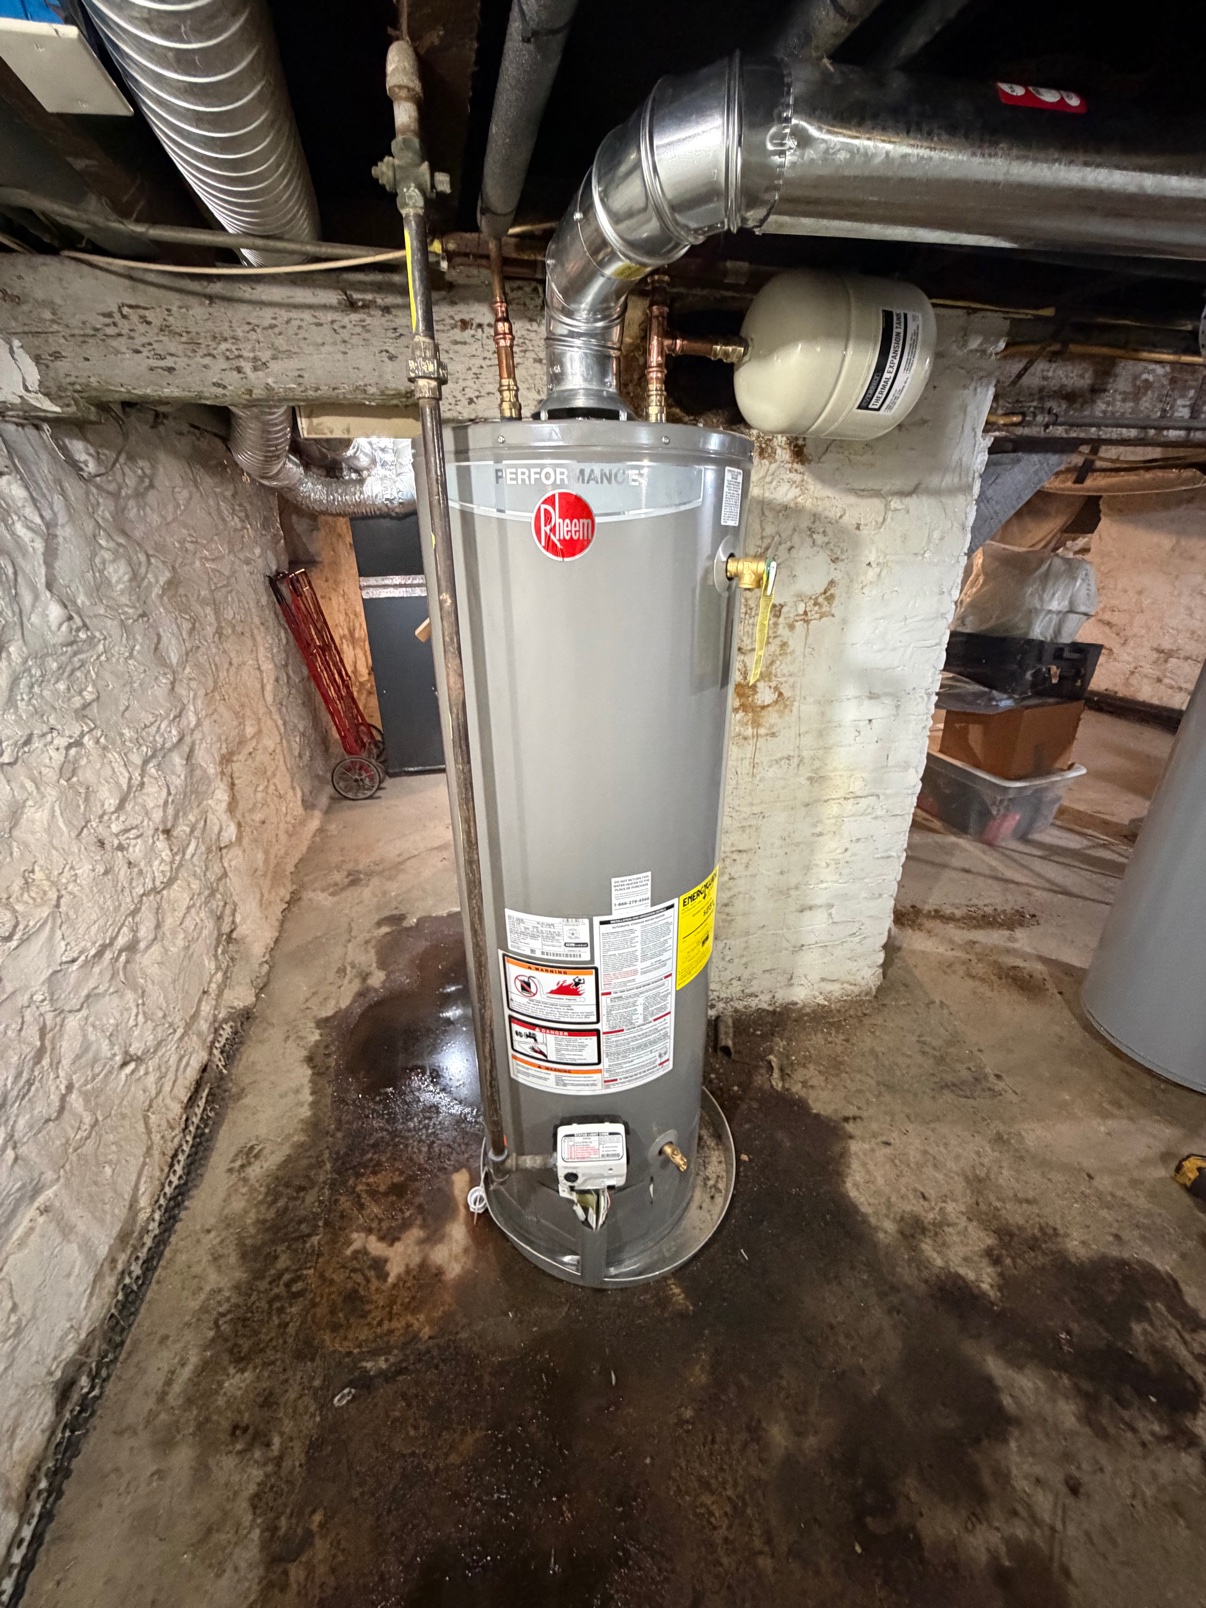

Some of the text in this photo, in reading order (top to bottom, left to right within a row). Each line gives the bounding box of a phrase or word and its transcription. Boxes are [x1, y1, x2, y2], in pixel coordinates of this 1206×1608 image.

[871, 375, 892, 407] THERMAL
[886, 331, 902, 375] EXPANSION
[894, 312, 902, 330] TANK
[539, 492, 592, 549] Rheem
[534, 967, 567, 975] WARNING
[541, 1028, 569, 1036] DANGER
[545, 1066, 572, 1074] WARNING
